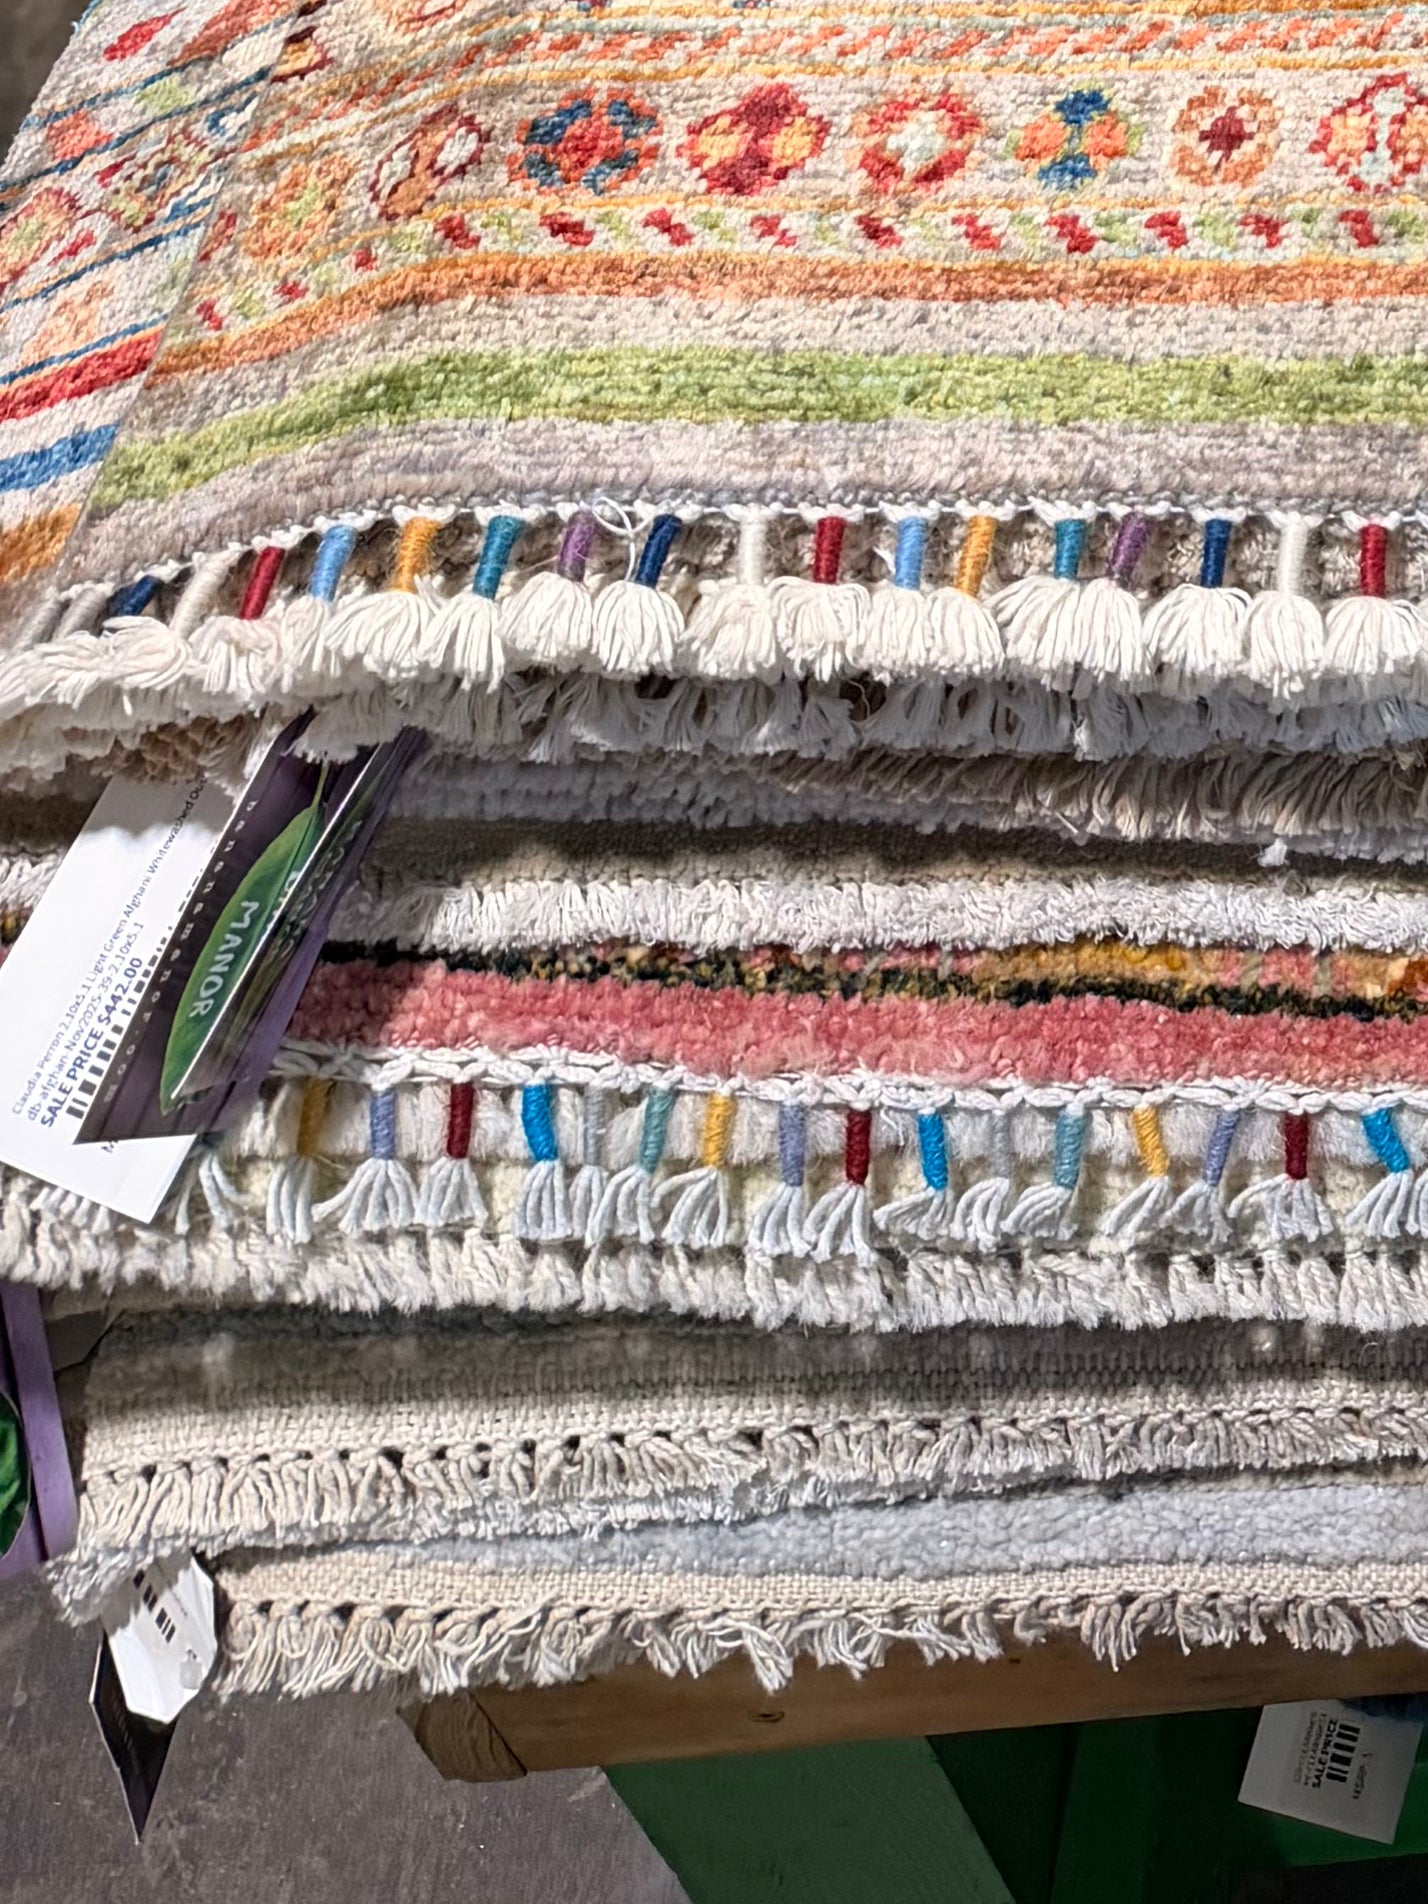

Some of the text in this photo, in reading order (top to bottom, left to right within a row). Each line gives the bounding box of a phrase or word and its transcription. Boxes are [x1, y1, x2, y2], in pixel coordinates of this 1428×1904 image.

[12, 1074, 43, 1115] Claudia
[38, 1037, 62, 1070] Perron
[86, 949, 109, 985] Light
[103, 917, 128, 954] Green
[123, 873, 152, 919] Afghani
[148, 799, 195, 875] Whitewashed
[40, 957, 143, 1128] SALE PRICE $442.00
[189, 900, 260, 1018] MANOR
